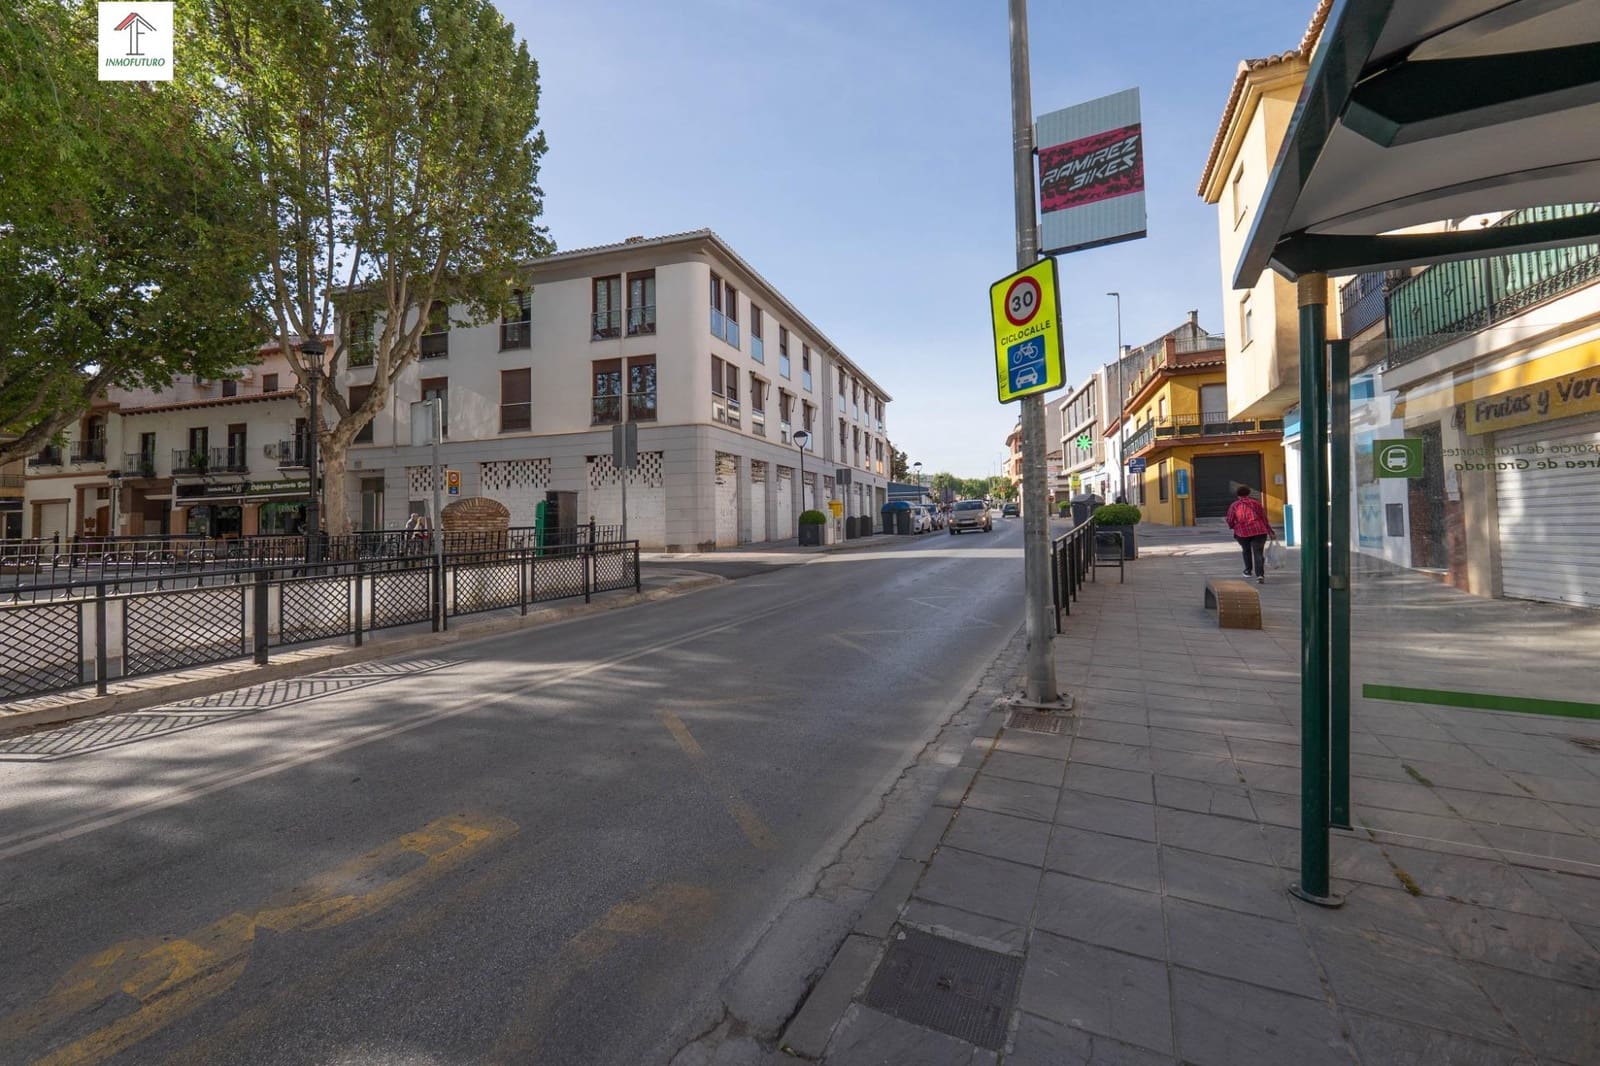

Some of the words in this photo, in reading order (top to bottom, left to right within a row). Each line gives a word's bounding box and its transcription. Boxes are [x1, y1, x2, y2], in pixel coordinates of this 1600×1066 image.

[1012, 290, 1034, 312] 30
[1000, 319, 1051, 346] CICLOCALLE
[1475, 394, 1531, 422] Frutas
[1538, 390, 1550, 415] y
[1556, 376, 1600, 402] Ver
